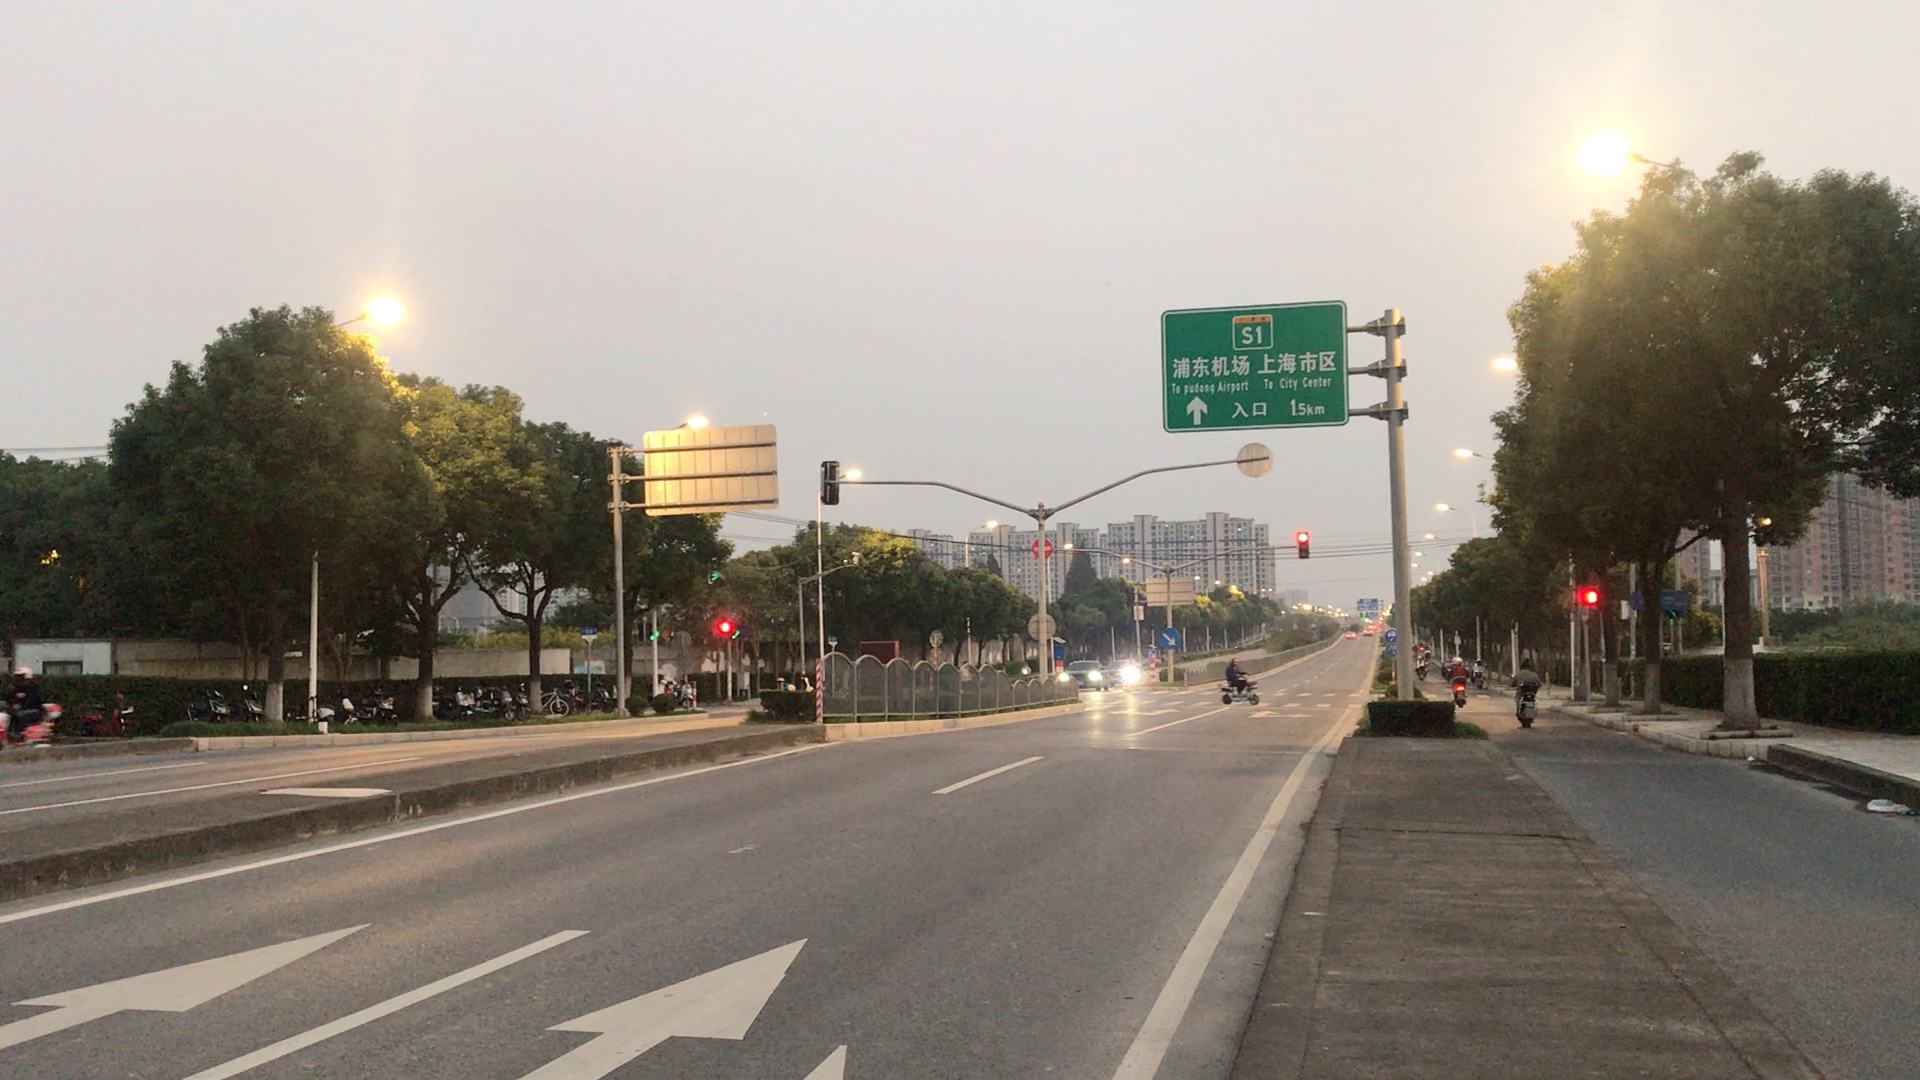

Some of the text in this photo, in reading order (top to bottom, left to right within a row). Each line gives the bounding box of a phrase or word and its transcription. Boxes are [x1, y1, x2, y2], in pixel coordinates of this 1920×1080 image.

[1241, 326, 1262, 345] S1
[1172, 351, 1337, 379] 浦东机场 上海市区
[1171, 383, 1181, 394] To
[1217, 381, 1249, 393] Airport
[1264, 378, 1274, 390] To
[1279, 377, 1298, 391] City
[1302, 376, 1332, 388] Center
[1231, 402, 1267, 418] 入口
